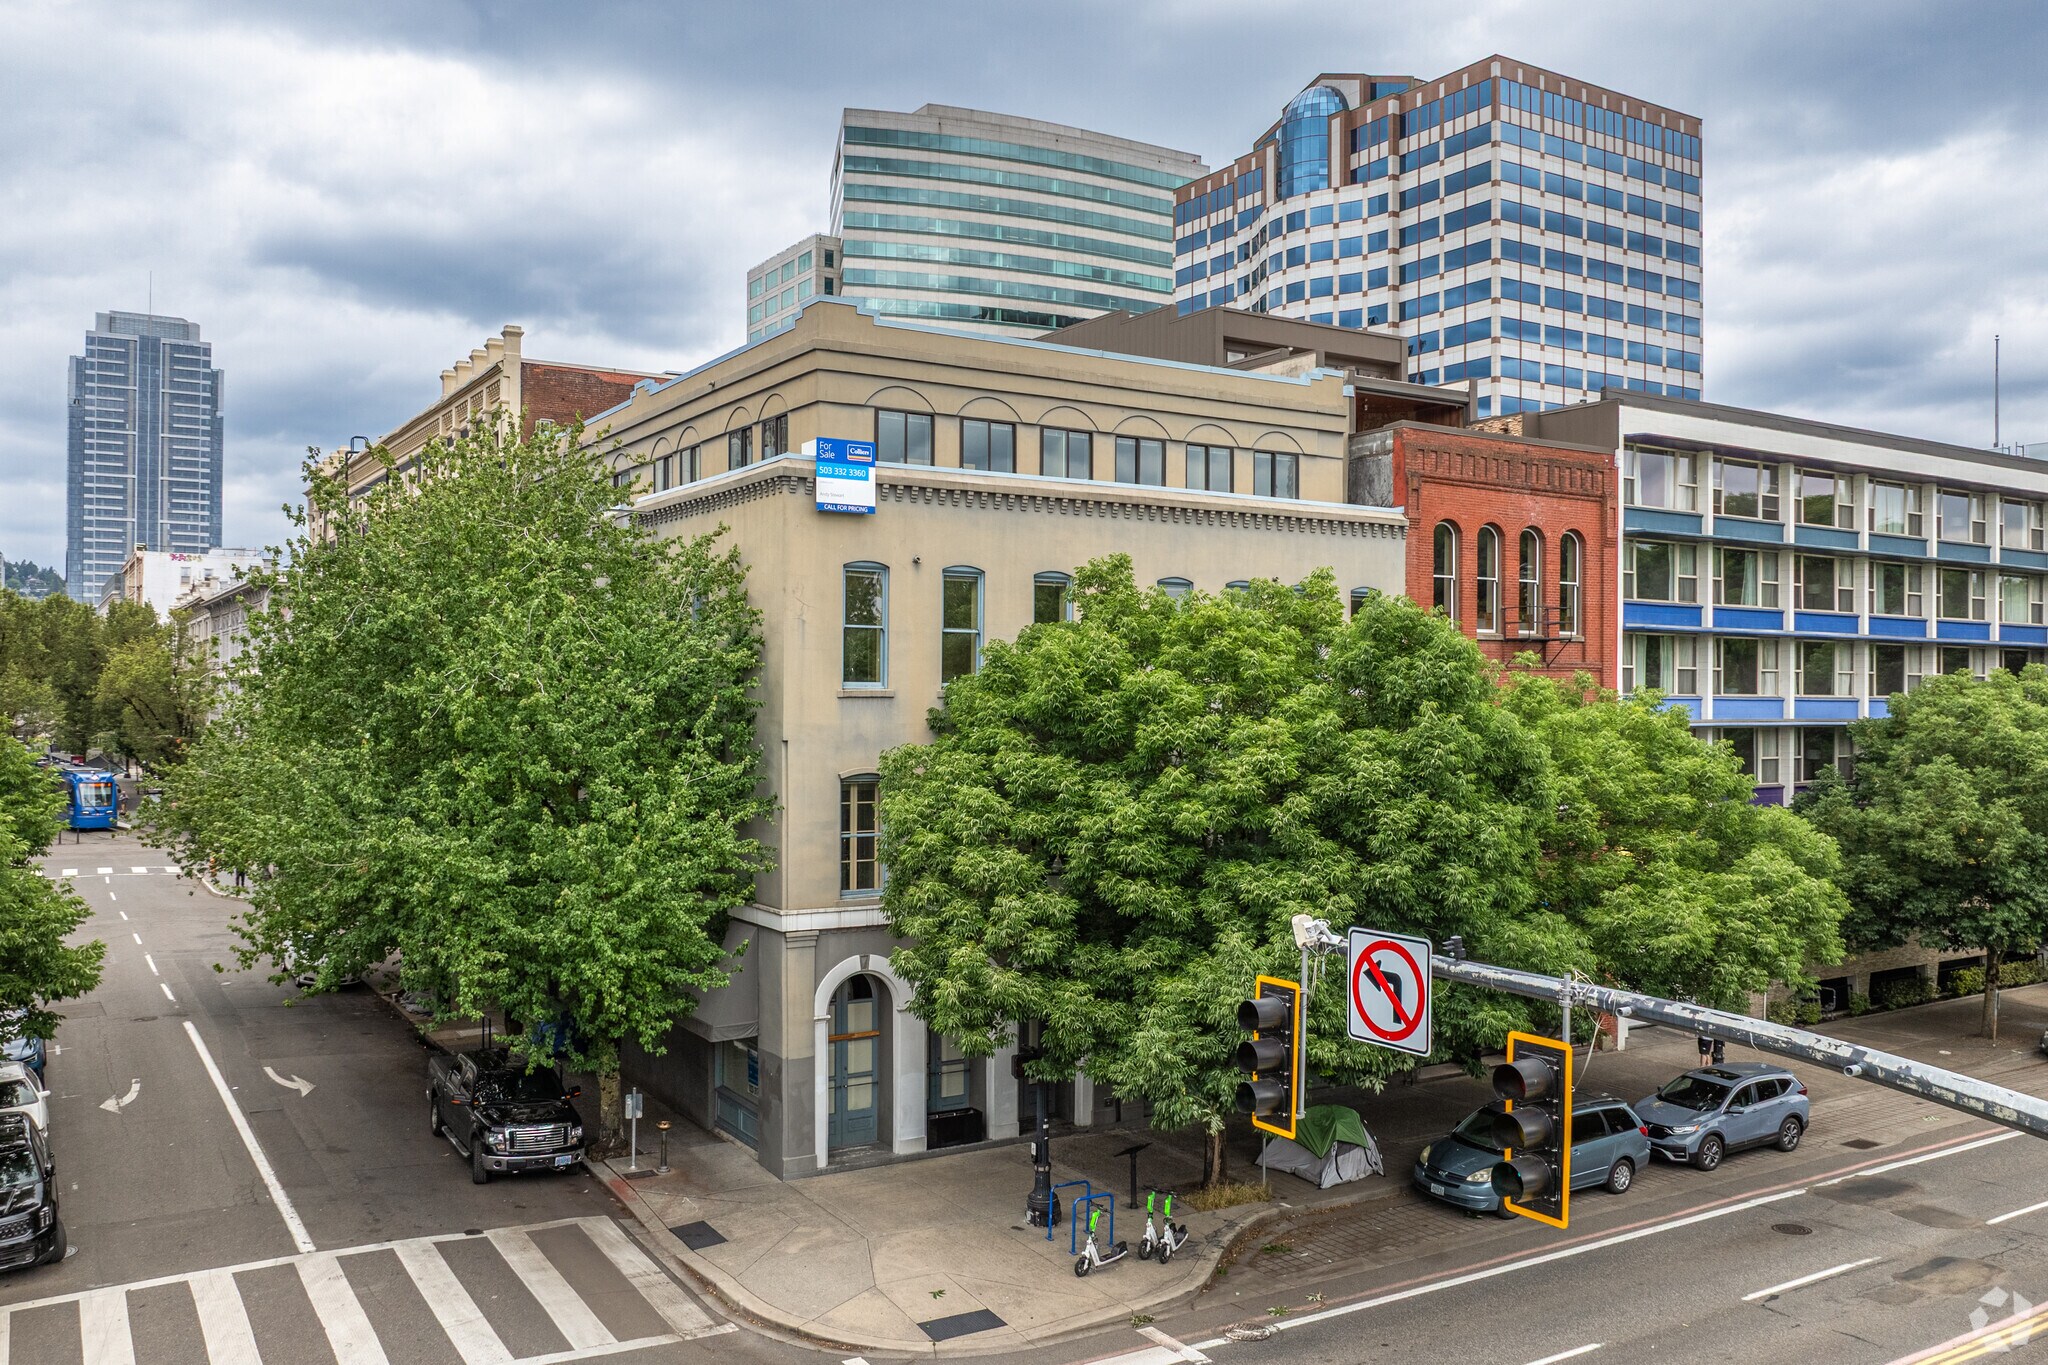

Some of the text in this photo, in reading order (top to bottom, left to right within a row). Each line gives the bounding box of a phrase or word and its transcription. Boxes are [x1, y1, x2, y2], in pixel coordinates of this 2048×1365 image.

[819, 441, 832, 450] For
[820, 450, 835, 459] Sale
[819, 466, 866, 478] 503 332 3360
[824, 503, 836, 511] CALL
[848, 505, 868, 513] PRICING
